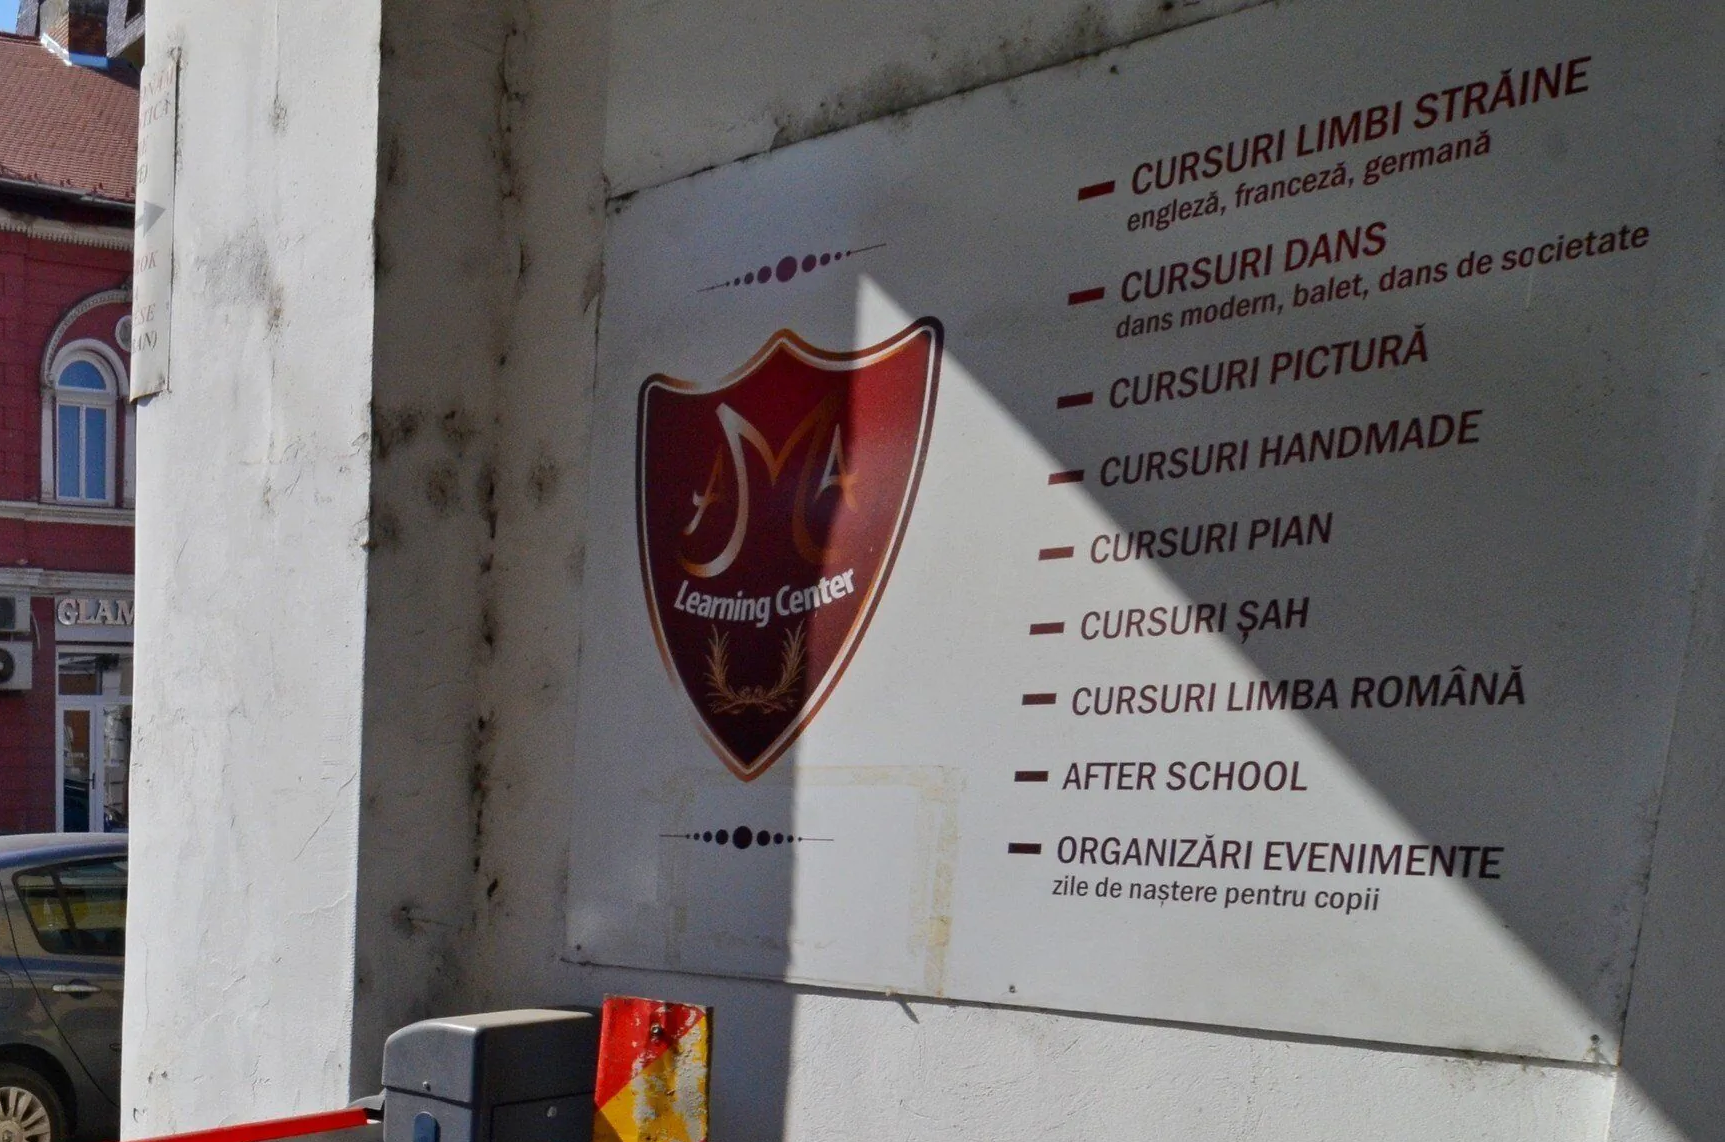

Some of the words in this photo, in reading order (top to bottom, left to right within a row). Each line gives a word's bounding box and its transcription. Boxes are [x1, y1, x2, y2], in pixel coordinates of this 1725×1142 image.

[1131, 128, 1285, 195] CURSURI
[1296, 100, 1404, 158] LIMBI
[1412, 56, 1593, 130] STRĂINE
[1126, 190, 1228, 233] engleză,
[1235, 161, 1355, 206] franceză,
[1363, 128, 1493, 187] germană
[1115, 311, 1174, 340] dans
[1180, 292, 1284, 331] modern,
[1292, 272, 1371, 310] balet,
[1378, 259, 1448, 294] dans
[1457, 249, 1493, 279] de
[1500, 224, 1651, 271] societate
[1120, 243, 1273, 303] CURSURI
[1283, 221, 1388, 273] DANS
[1108, 356, 1259, 409] CURSURI
[1270, 323, 1430, 385] PICTURĂ
[1099, 438, 1249, 488] CURSURI
[1258, 409, 1484, 469] HANDMADE
[1089, 521, 1239, 565] CURSURI
[1248, 511, 1334, 551] PIAN
[674, 579, 771, 628] Learning
[775, 568, 855, 617] Center
[1079, 602, 1227, 641] CURSURI
[1236, 597, 1310, 645] ȘAH
[1071, 682, 1216, 716] CURSURI
[1226, 679, 1339, 713] LIMBA
[1349, 665, 1527, 710] ROMÂNĂ
[1062, 761, 1157, 792] AFTER
[1165, 760, 1309, 793] SCHOOL
[1056, 834, 1253, 871] ORGANIZĂRI
[1262, 841, 1505, 880] EVENIMENTE
[1051, 875, 1089, 898] zile
[1095, 877, 1124, 900] de
[1129, 881, 1218, 909] naștere
[1224, 885, 1307, 909] pentru
[1314, 887, 1382, 915] copii
